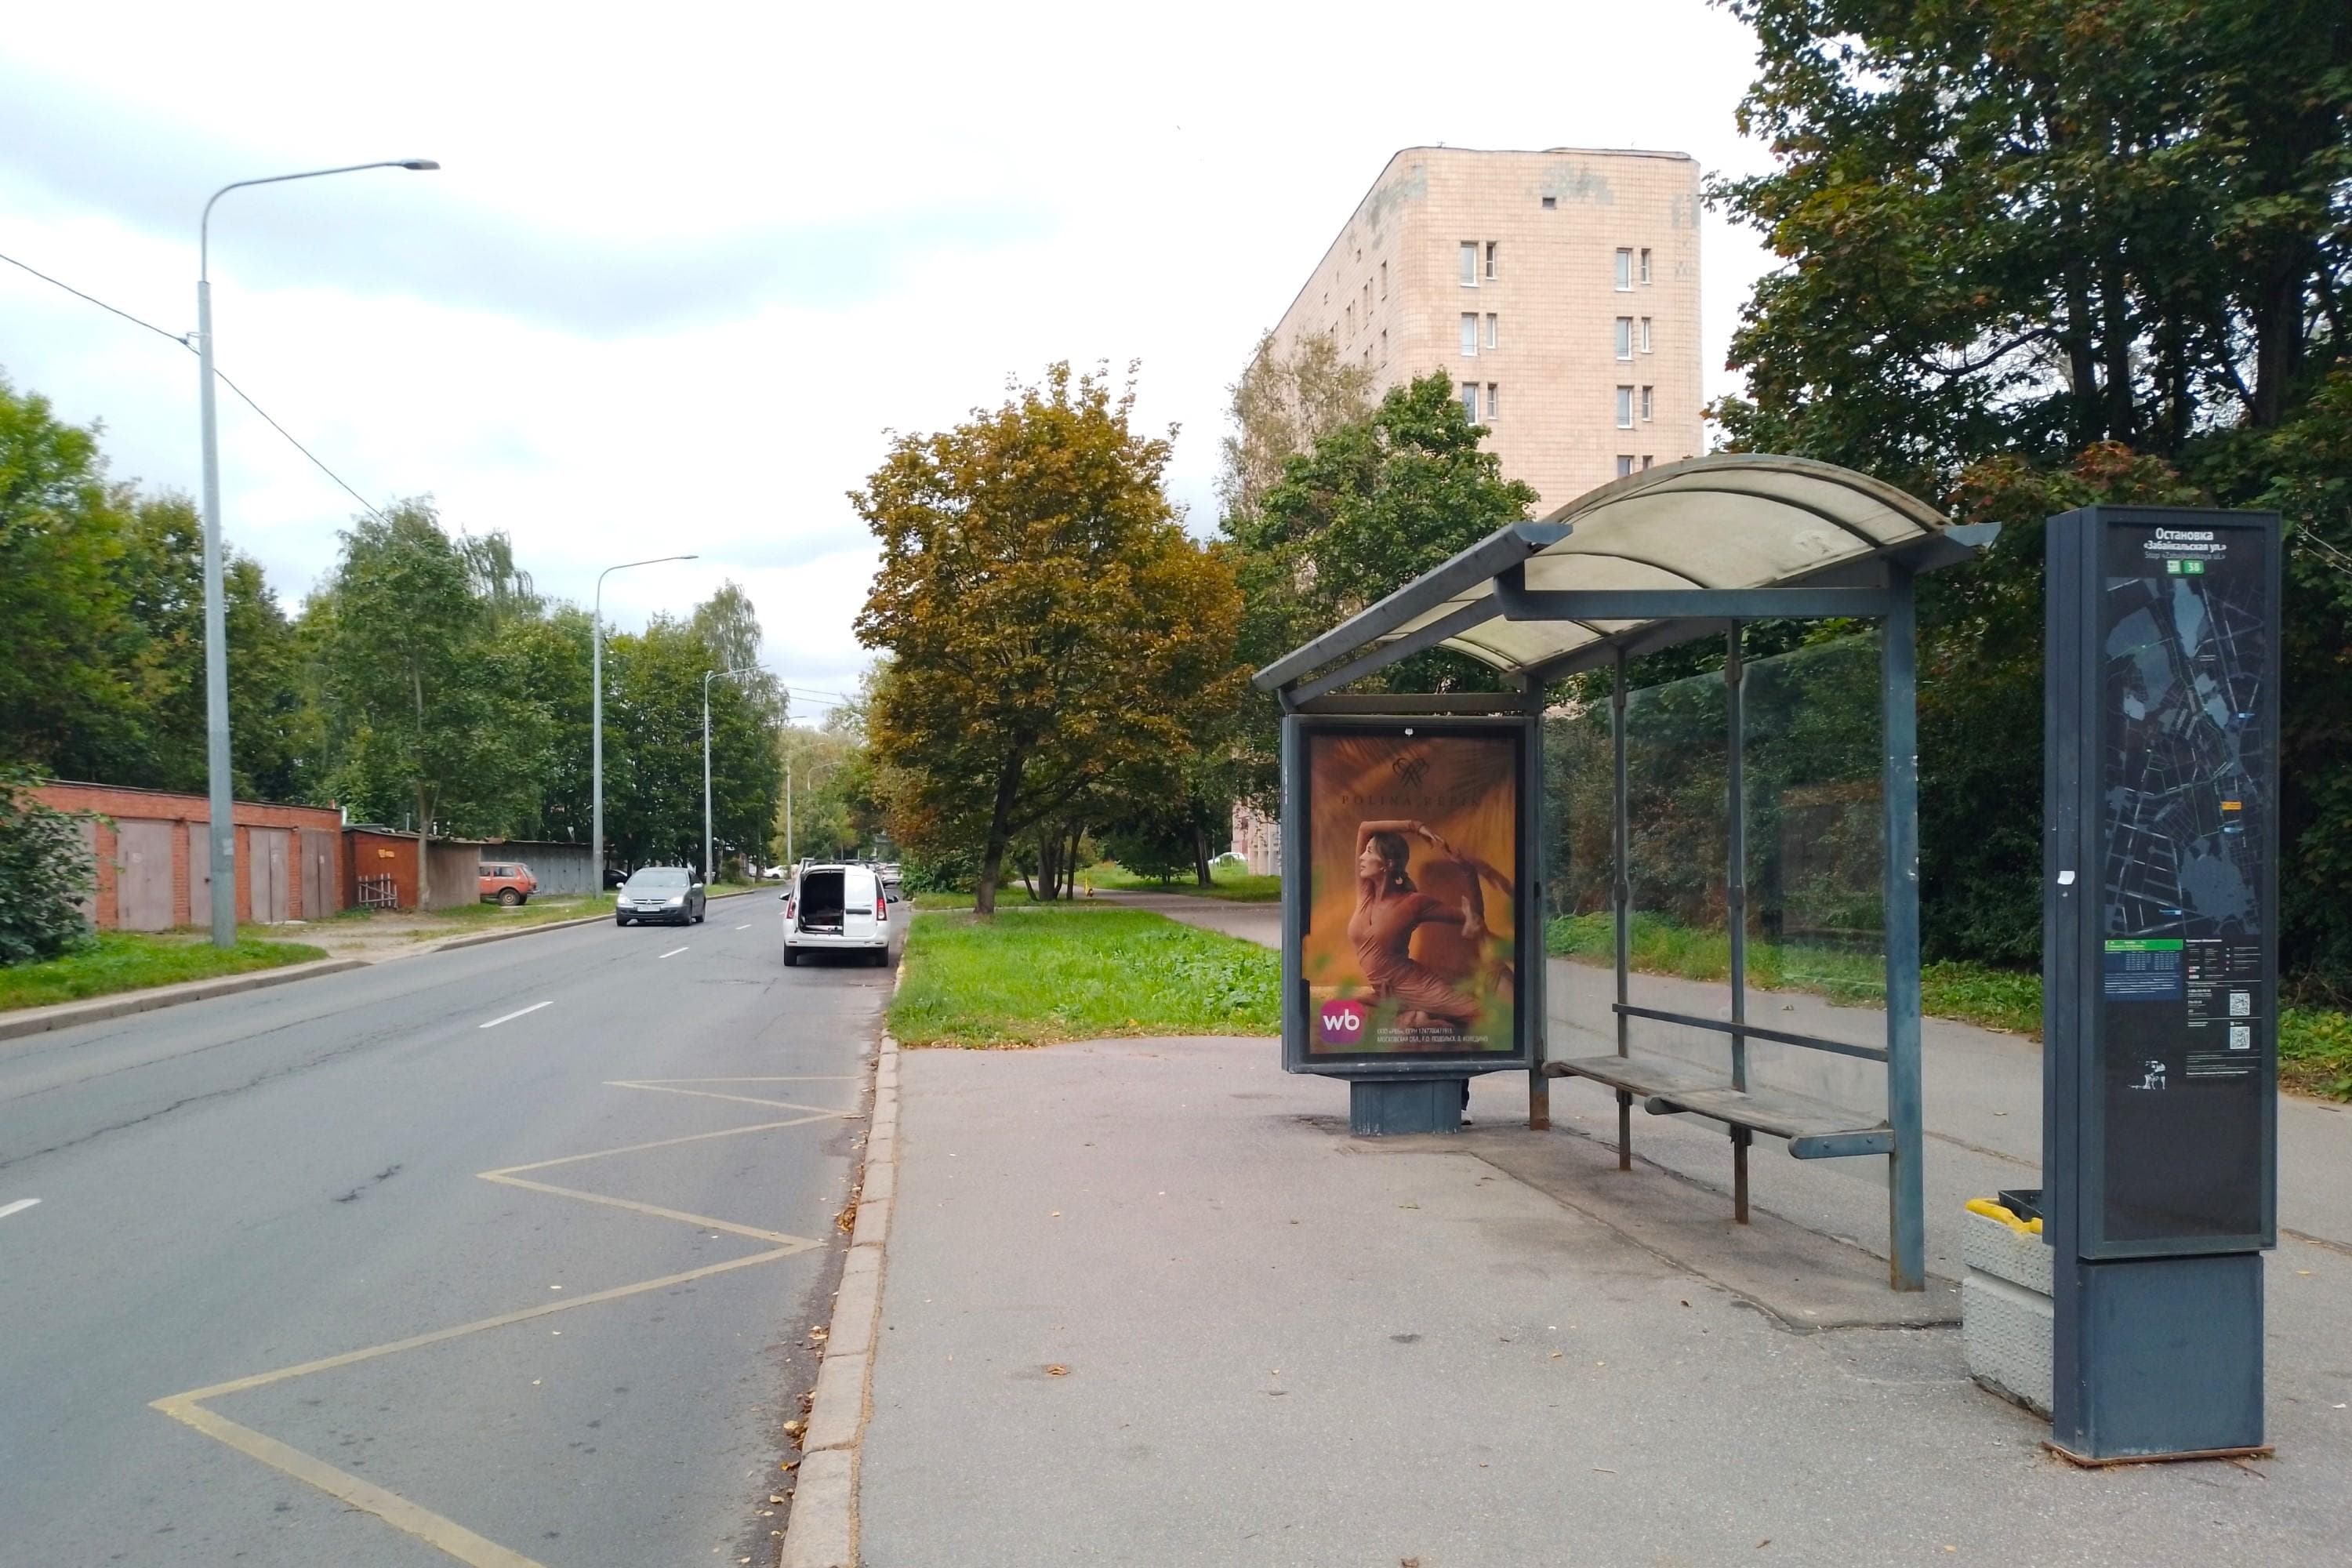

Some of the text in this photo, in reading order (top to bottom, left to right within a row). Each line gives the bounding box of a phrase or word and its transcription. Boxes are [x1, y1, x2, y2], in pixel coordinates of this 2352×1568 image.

[2154, 527, 2214, 541] Остановка
[1341, 795, 1411, 806] POLINA
[1323, 1008, 1360, 1031] wb
